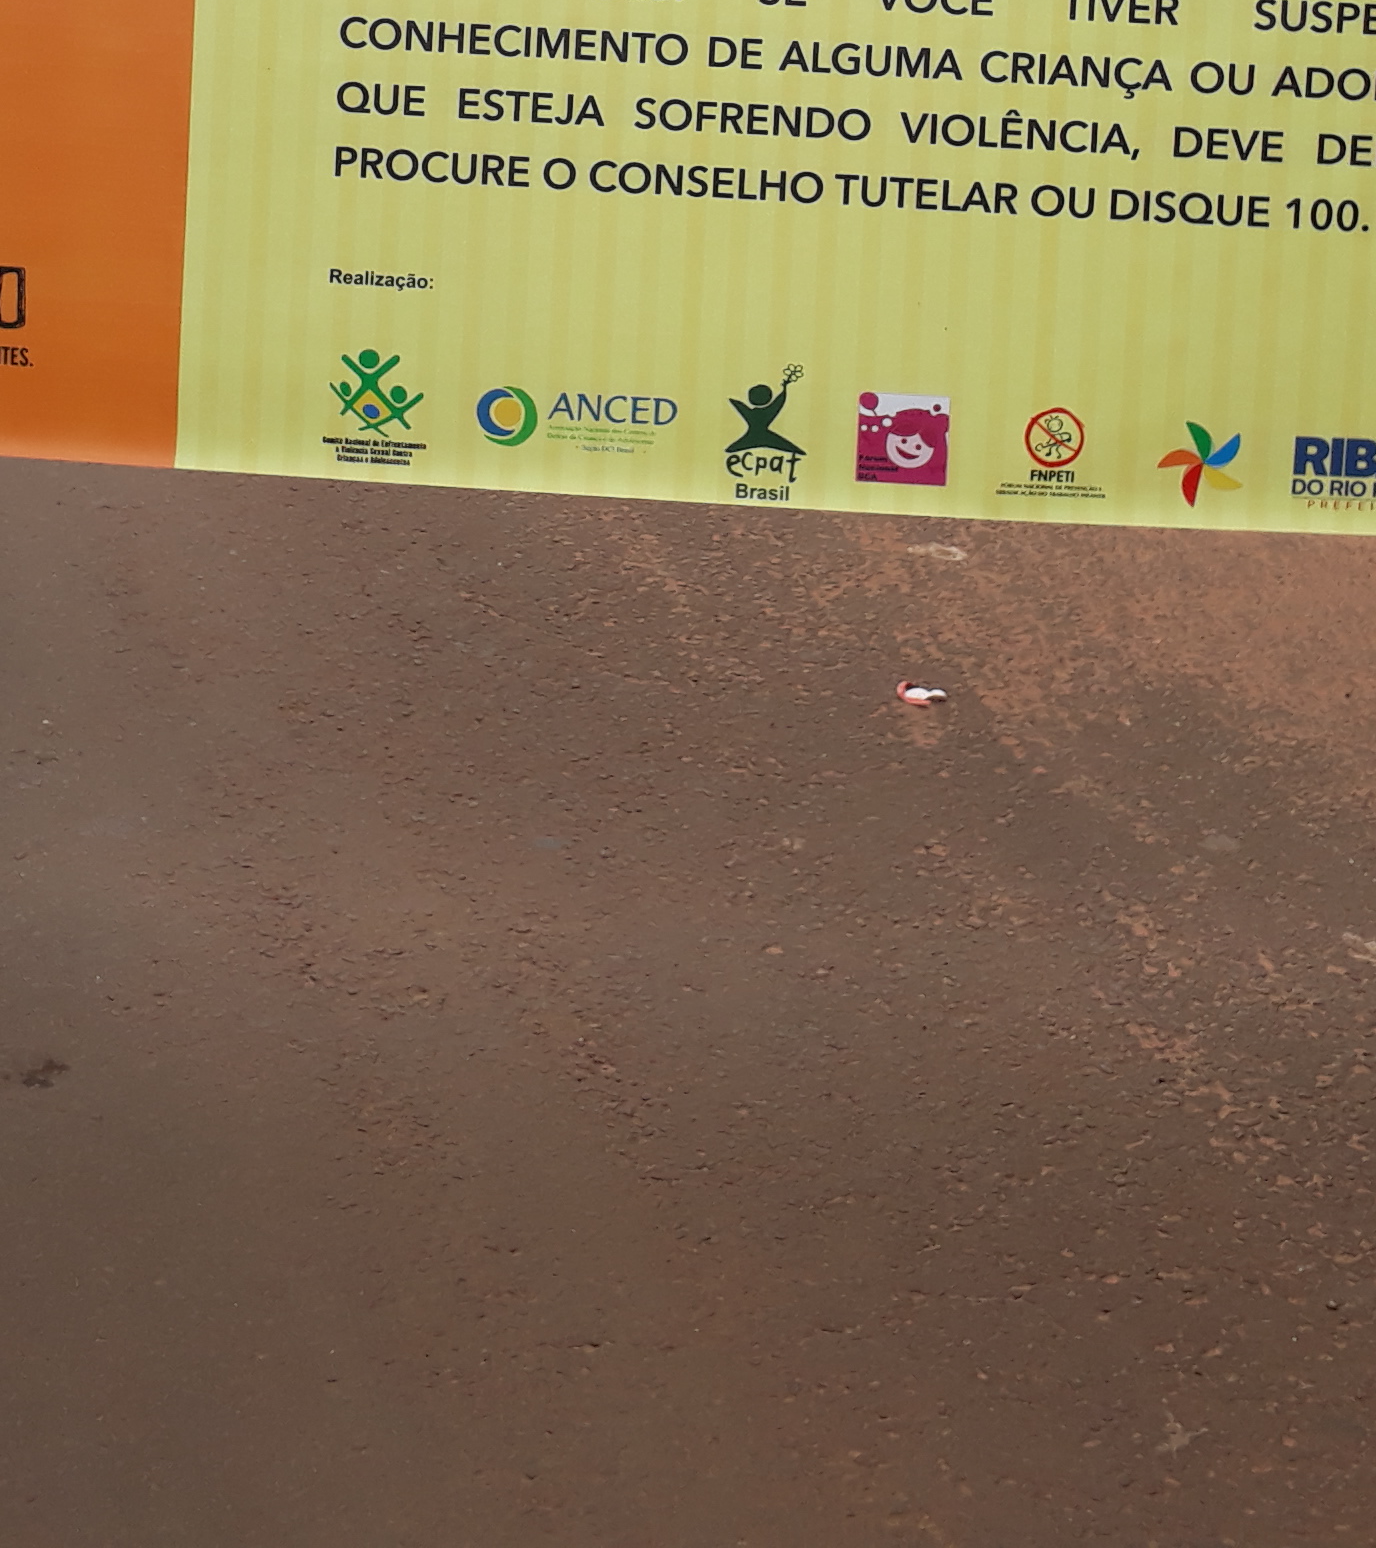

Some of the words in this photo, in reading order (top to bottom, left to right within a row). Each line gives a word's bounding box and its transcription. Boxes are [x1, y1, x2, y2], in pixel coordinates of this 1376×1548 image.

[340, 17, 688, 65] CONHECIMENTO
[709, 37, 762, 69] DE
[779, 41, 962, 80] ALGUMA
[981, 51, 1172, 99] CRIANÇA
[1191, 62, 1255, 95] OU
[337, 82, 425, 116] QUE
[459, 88, 604, 126] ESTEJA
[635, 98, 871, 140] SOFRENDO
[901, 110, 1139, 160] VIOLÊNCIA,
[1174, 127, 1283, 162] DEVE
[335, 147, 529, 187] PROCURE
[544, 158, 576, 189] O
[590, 161, 823, 203] CONSELHO
[835, 174, 1017, 214] TUTELAR
[1031, 185, 1095, 218] OU
[1110, 189, 1270, 227] DISQUE
[1287, 198, 1368, 231] 100.
[330, 269, 435, 291] Realização:
[547, 393, 678, 426] ANCED
[725, 452, 807, 484] ecpat
[1030, 469, 1074, 483] FNPETI
[735, 483, 789, 502] Brasil
[1291, 479, 1322, 496] DO
[1329, 480, 1365, 497] RIO
